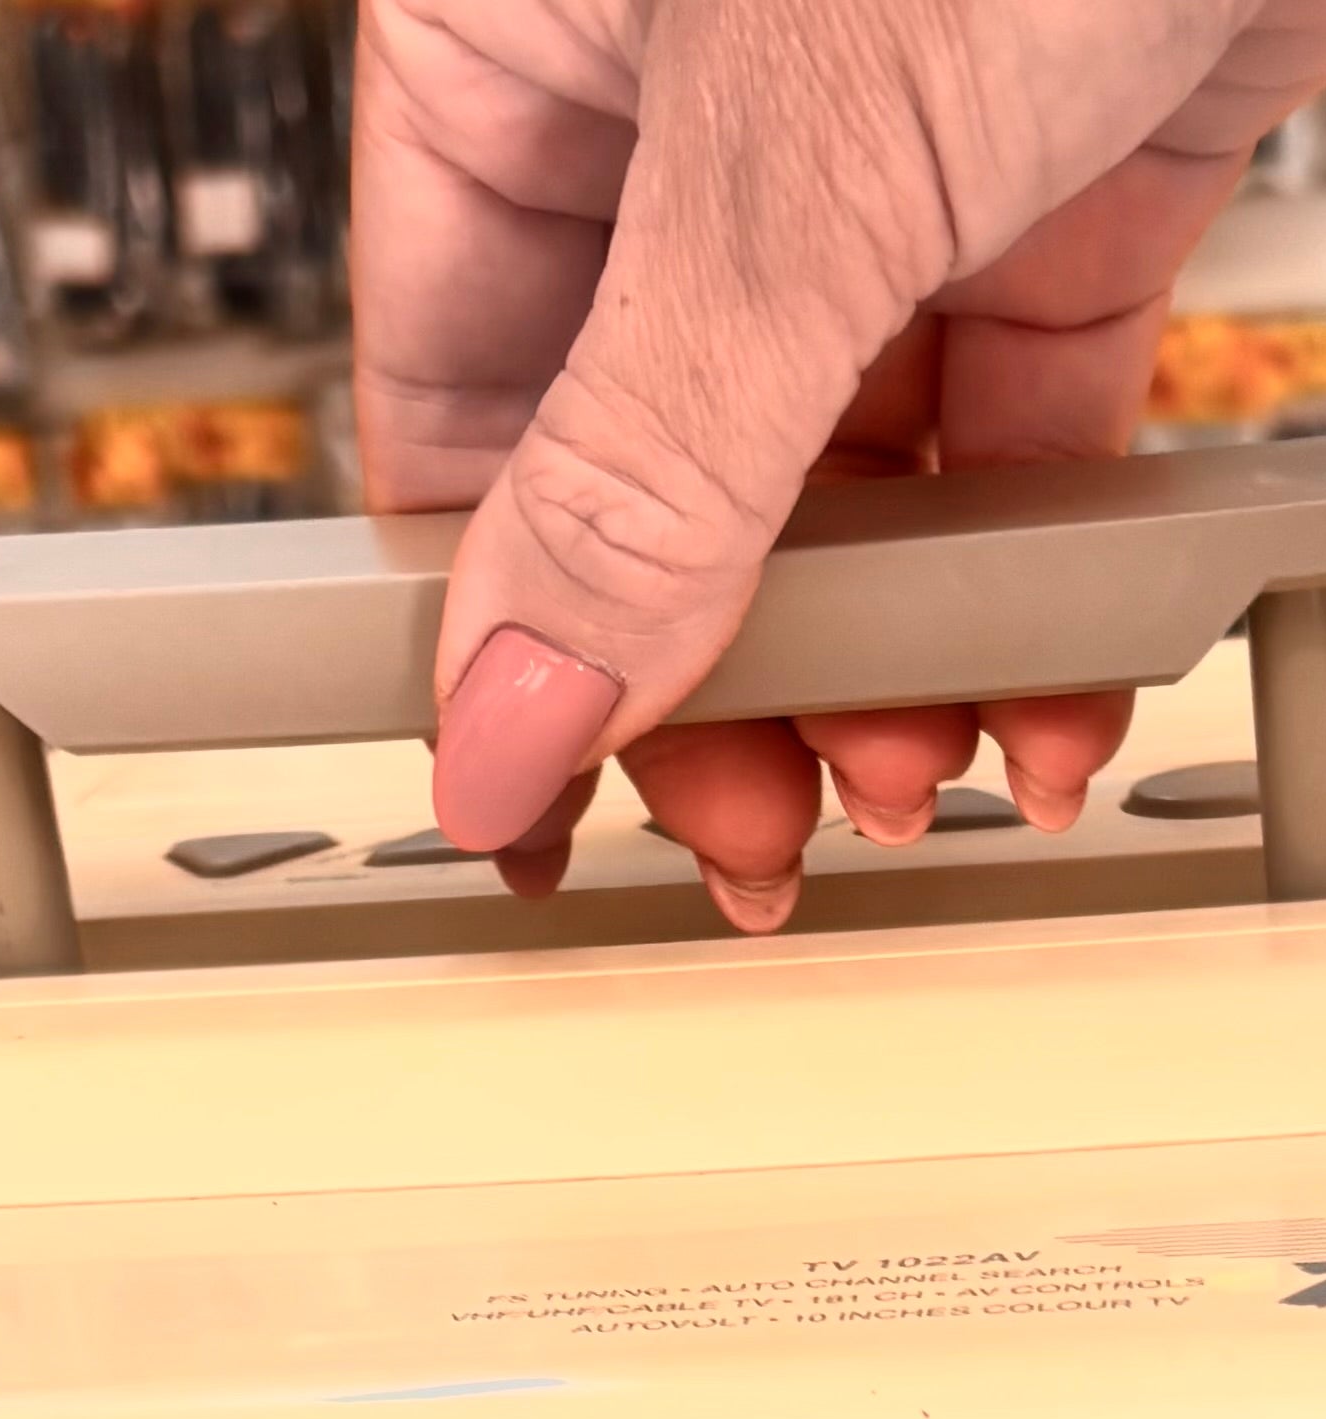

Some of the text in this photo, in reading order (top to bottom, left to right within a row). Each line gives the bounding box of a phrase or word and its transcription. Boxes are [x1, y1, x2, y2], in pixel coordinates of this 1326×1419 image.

[803, 1250, 1040, 1272] TV 1022AV
[544, 1287, 667, 1301] TUNING
[701, 1279, 794, 1293] AUTO
[805, 1272, 967, 1288] CHANNEL
[980, 1264, 1123, 1279] SEARCH
[734, 1297, 773, 1307] TV
[874, 1290, 924, 1302] CH
[957, 1287, 1000, 1297] AV
[1010, 1277, 1206, 1296] CONTROLS
[571, 1296, 1191, 1333] AUTOVOLT 10 INCHES COLOUR TV
